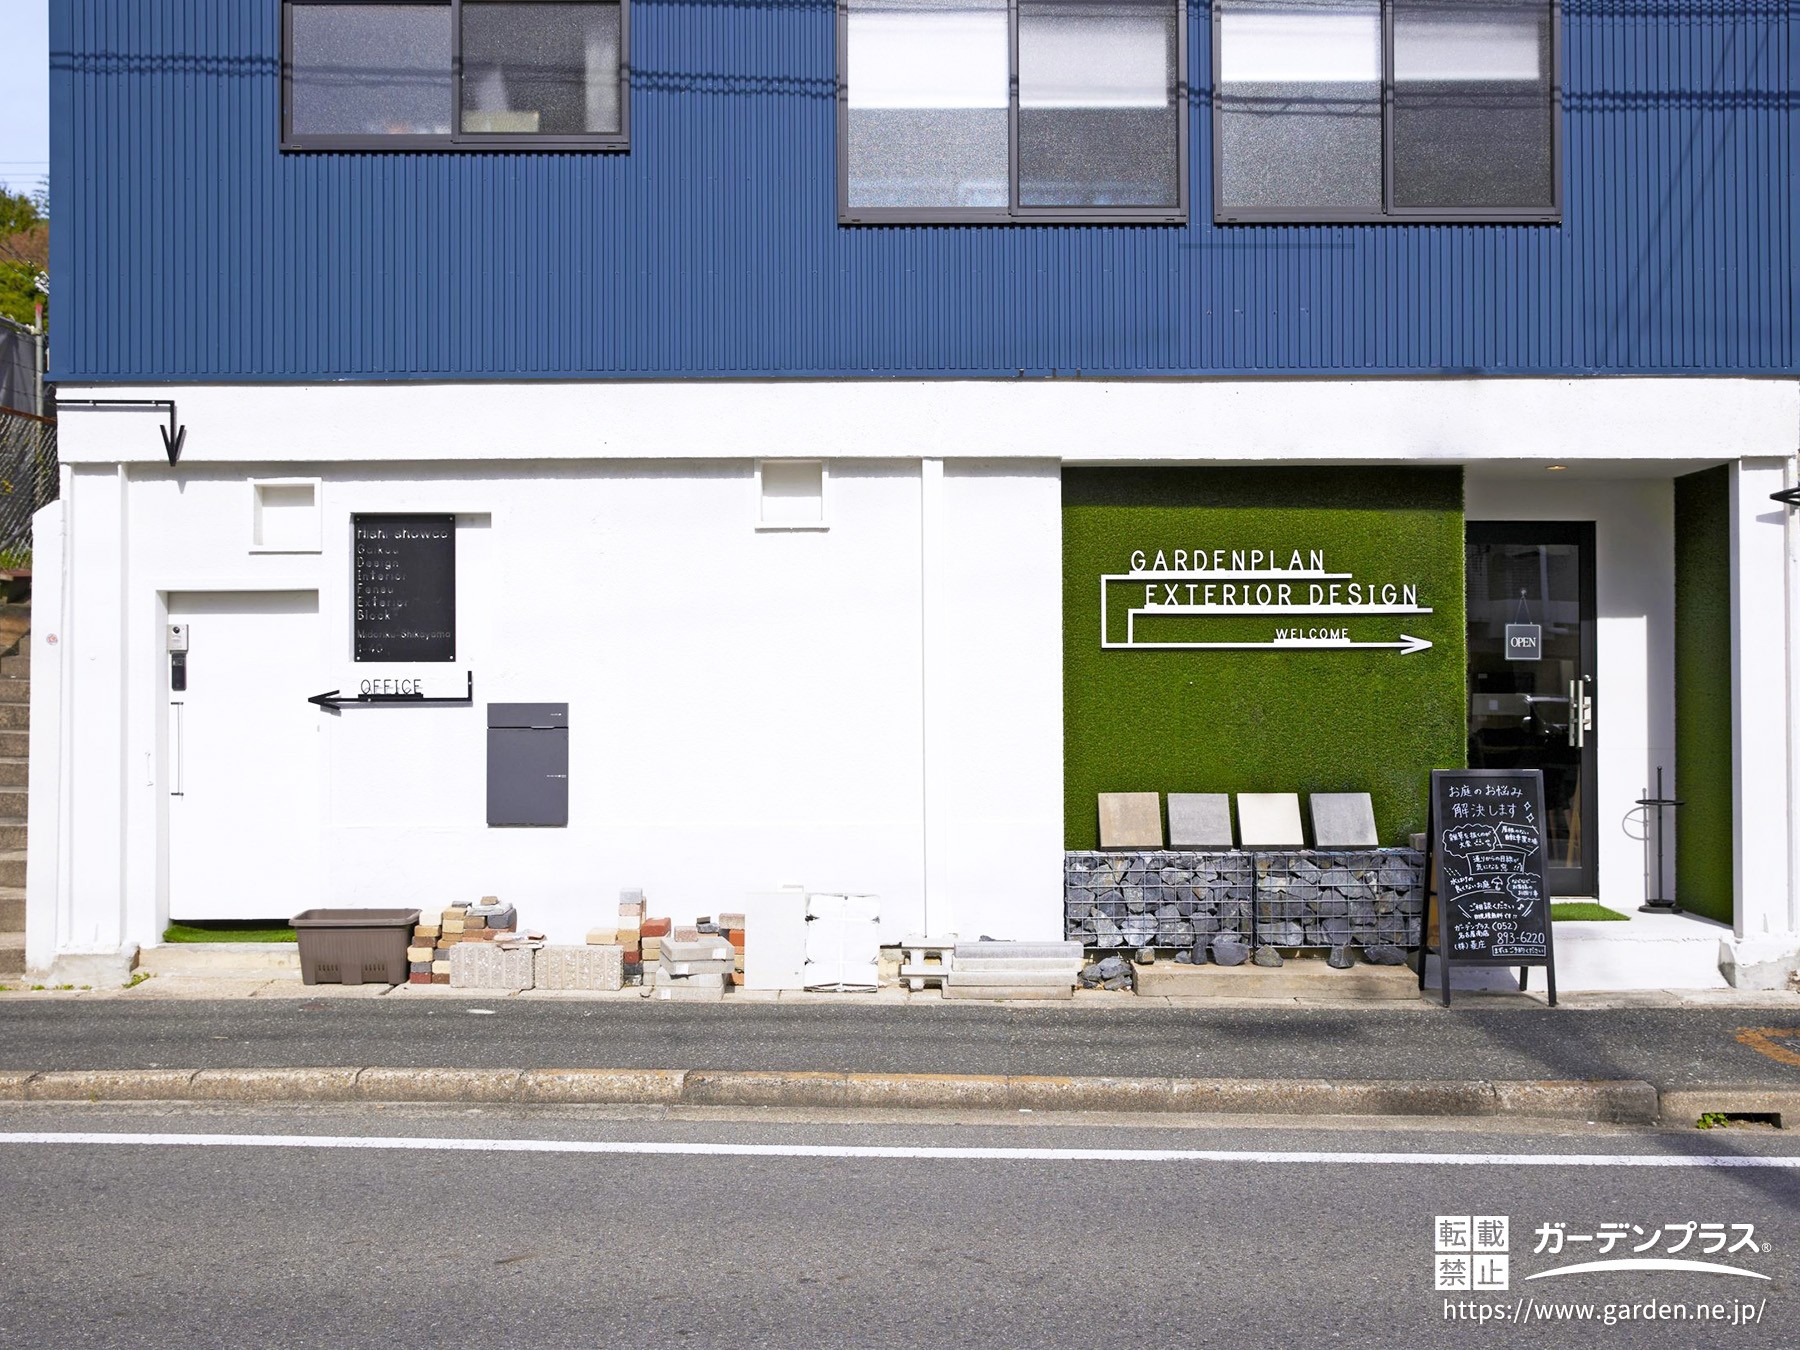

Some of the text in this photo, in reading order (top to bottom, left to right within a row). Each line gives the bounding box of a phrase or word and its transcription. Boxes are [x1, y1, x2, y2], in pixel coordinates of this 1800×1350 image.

[1130, 548, 1325, 571] GARDENPLAN
[1144, 583, 1418, 606] EXTERIOR DESIGN
[1275, 628, 1350, 640] WELCOME
[1510, 636, 1537, 648] OPEN
[360, 679, 423, 695] OFFICE
[1448, 785, 1523, 798] お庭のお悩み
[1452, 803, 1517, 818] 解決します
[1454, 922, 1490, 932] ガーデンプラス
[1491, 921, 1518, 931] (052)
[1497, 931, 1545, 945] 893-6220
